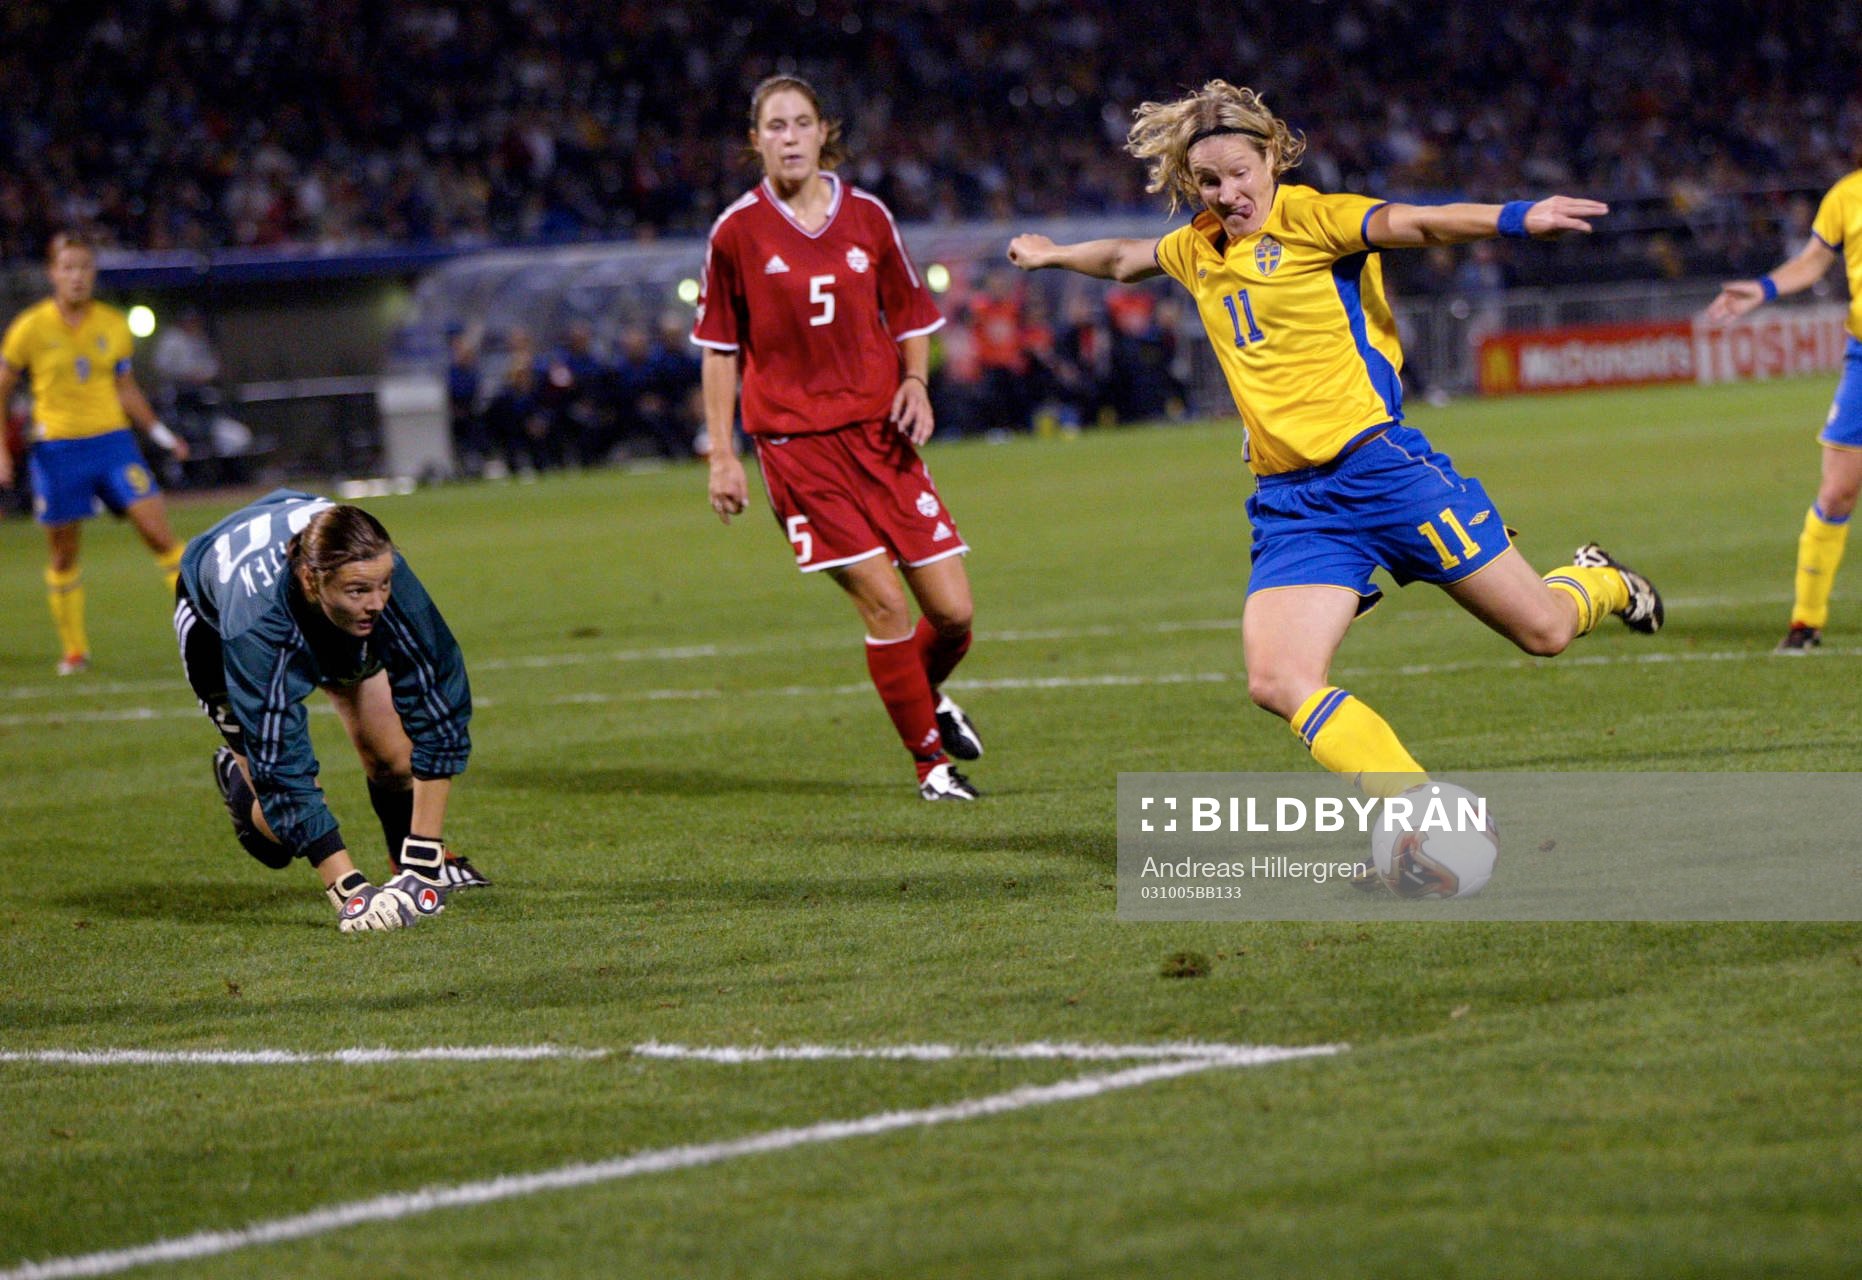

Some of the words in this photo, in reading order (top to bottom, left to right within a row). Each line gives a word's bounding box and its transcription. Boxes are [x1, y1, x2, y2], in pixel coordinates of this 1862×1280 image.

[809, 275, 836, 327] 5
[1222, 288, 1265, 347] 11
[786, 515, 812, 564] 5
[1417, 507, 1481, 570] 11
